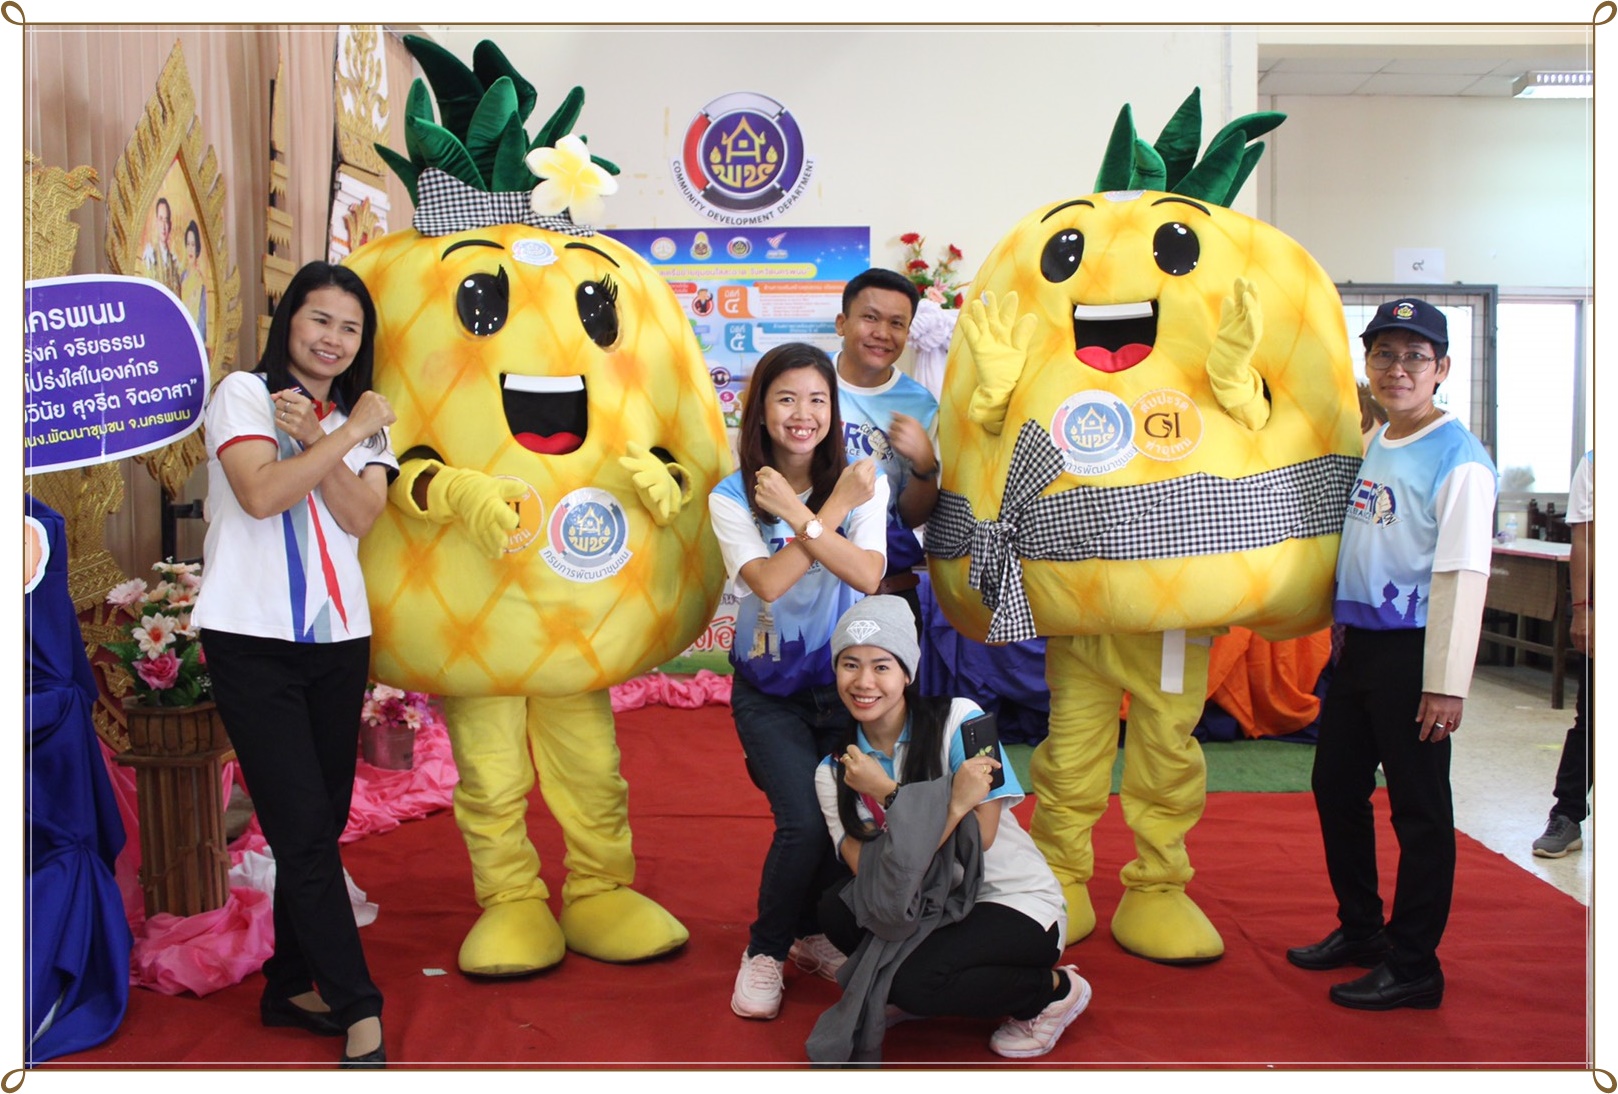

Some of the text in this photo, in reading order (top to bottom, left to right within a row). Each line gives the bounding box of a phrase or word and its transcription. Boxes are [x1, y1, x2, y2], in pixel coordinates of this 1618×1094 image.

[672, 159, 814, 226] COMMUNITY DEVELOPMENT DEPARTMENT
[64, 333, 146, 358] จริยธรรม
[25, 378, 197, 423] วินัย สุจริต จิตอาสา”
[128, 408, 191, 429] จ.นครพนม
[1144, 412, 1181, 438] GI
[543, 549, 630, 580] กรมการพัฒนาชุมชน
